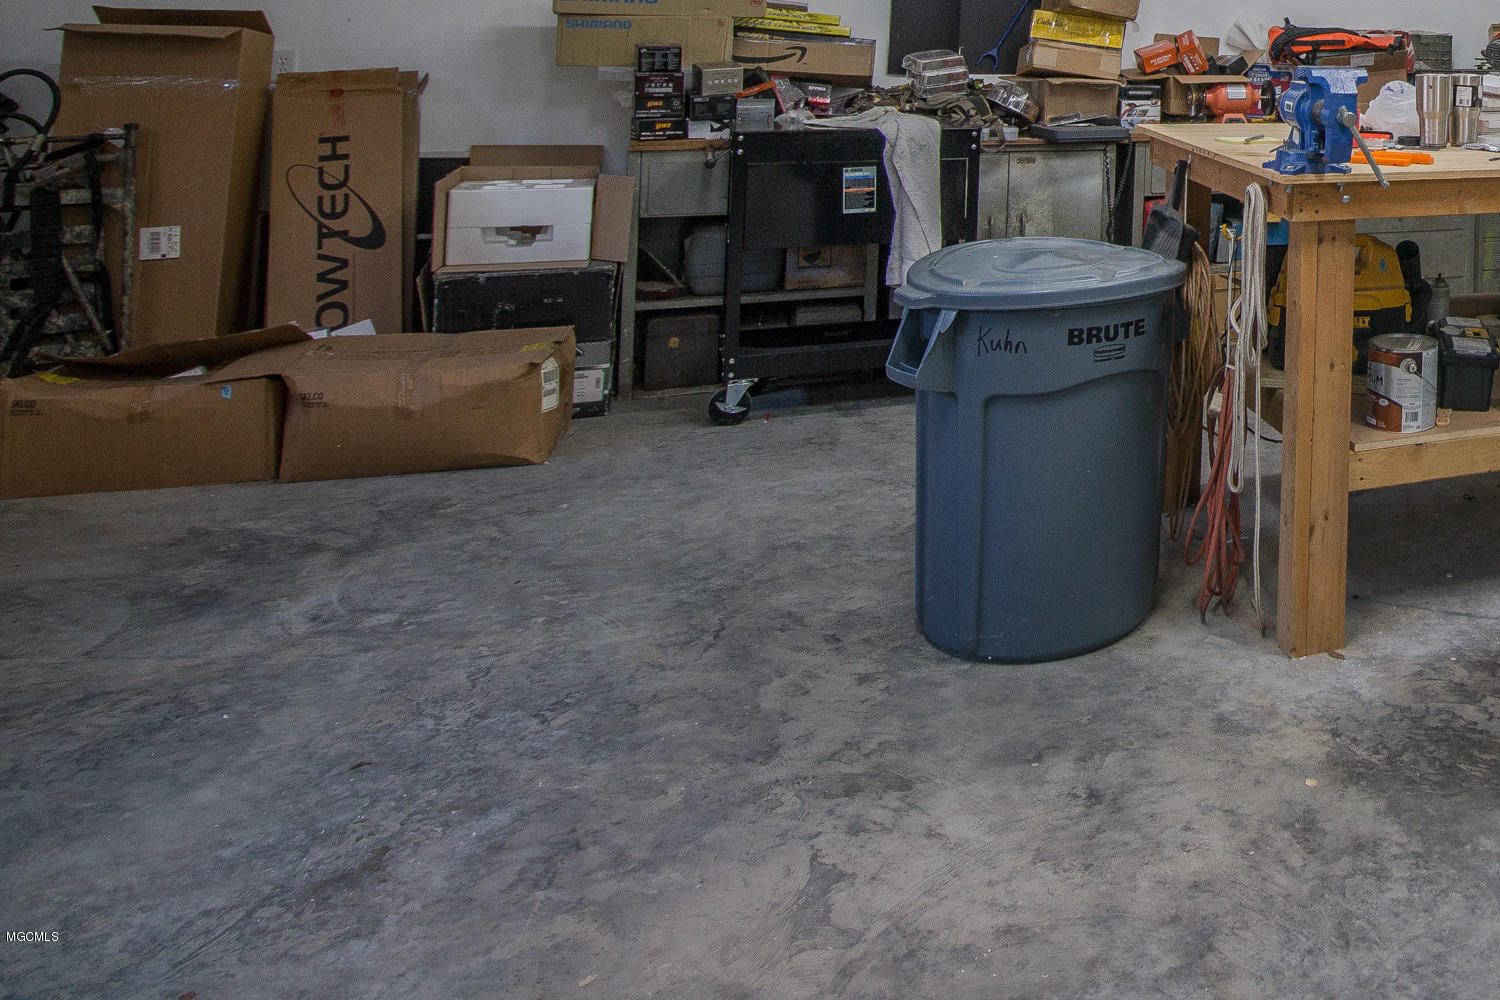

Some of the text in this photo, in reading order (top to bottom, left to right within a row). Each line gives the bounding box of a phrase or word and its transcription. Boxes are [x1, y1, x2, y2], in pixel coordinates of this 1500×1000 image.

[564, 18, 632, 30] SHIMANO
[315, 135, 350, 333] OWTECH
[977, 325, 1028, 357] Kuhn
[1067, 318, 1147, 346] BRUTE
